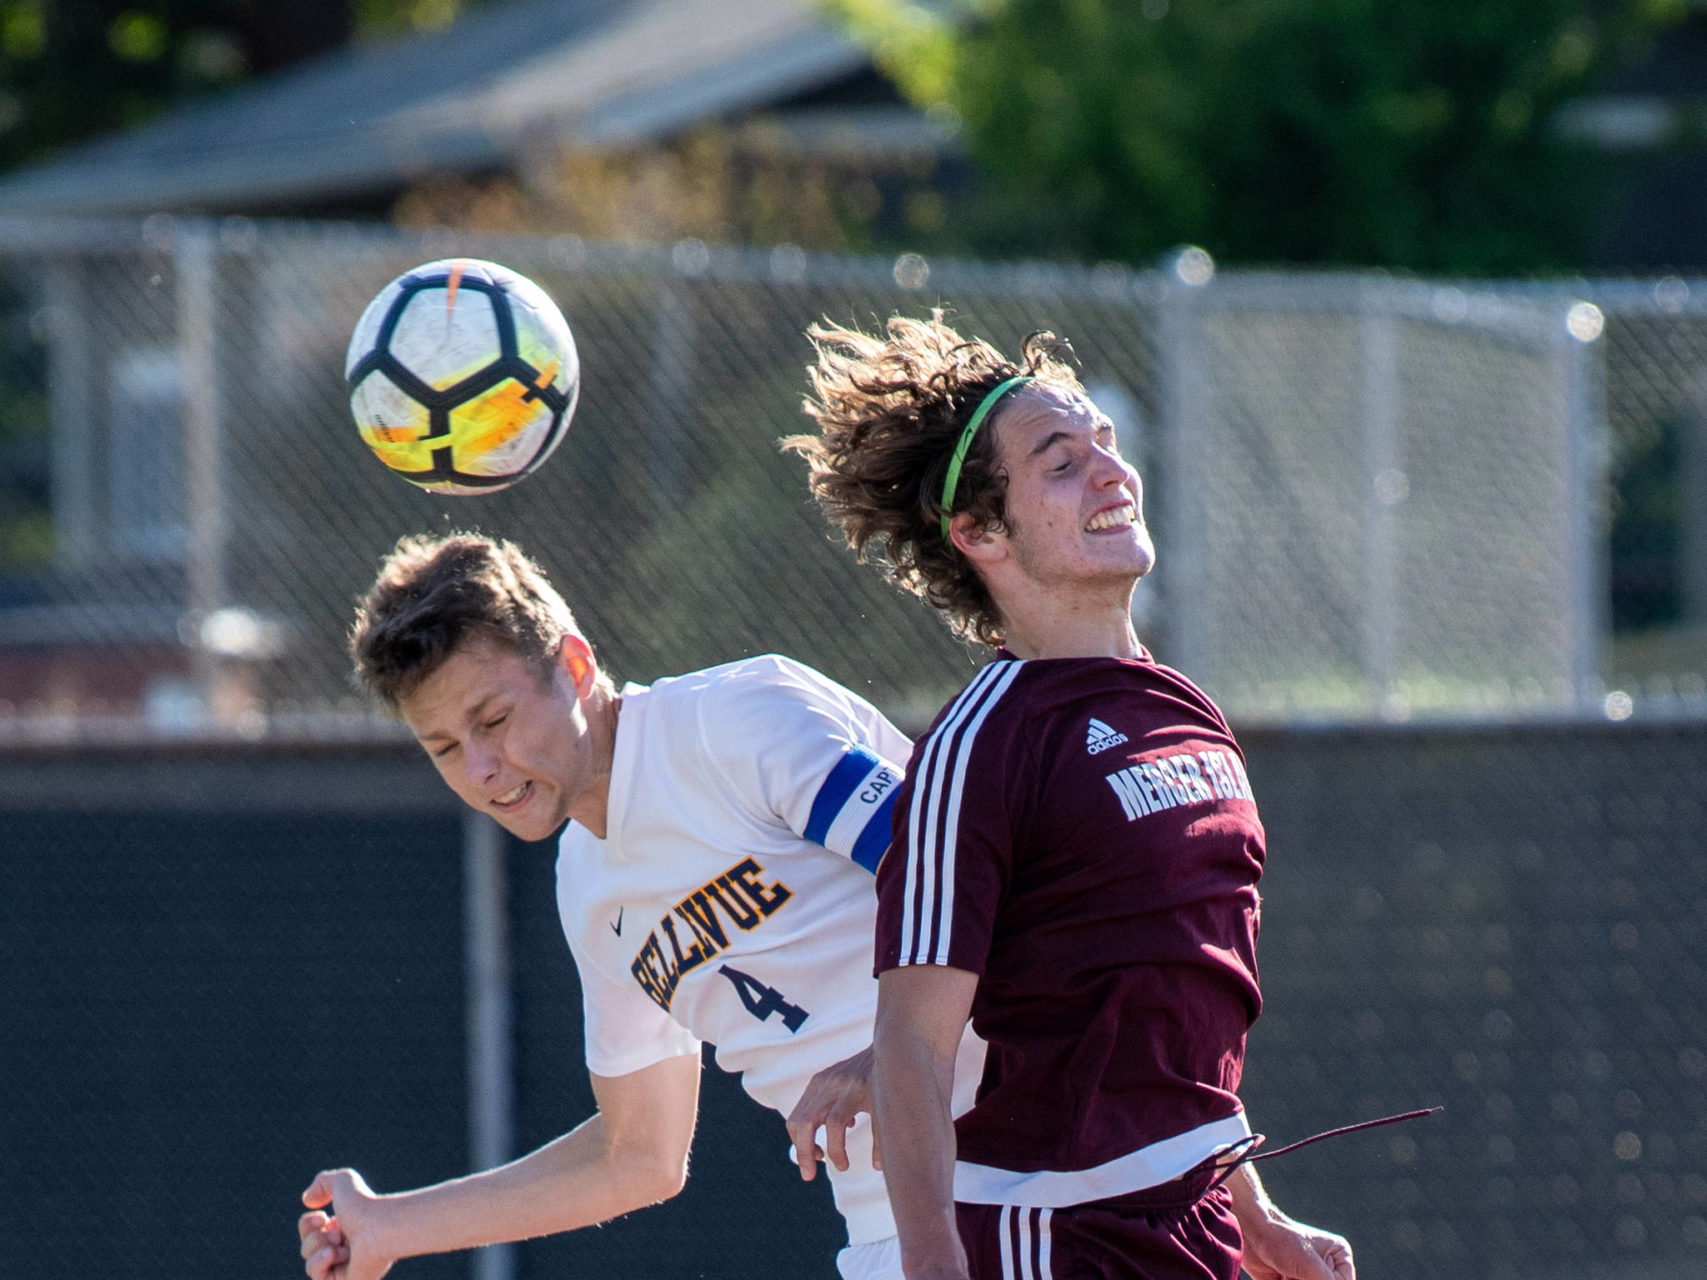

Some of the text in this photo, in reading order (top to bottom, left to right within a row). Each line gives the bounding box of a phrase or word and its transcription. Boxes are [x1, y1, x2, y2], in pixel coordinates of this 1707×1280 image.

[1087, 733, 1128, 755] adidas
[860, 766, 892, 805] CAP
[1105, 754, 1213, 822] MERCER
[718, 964, 810, 1034] 4
